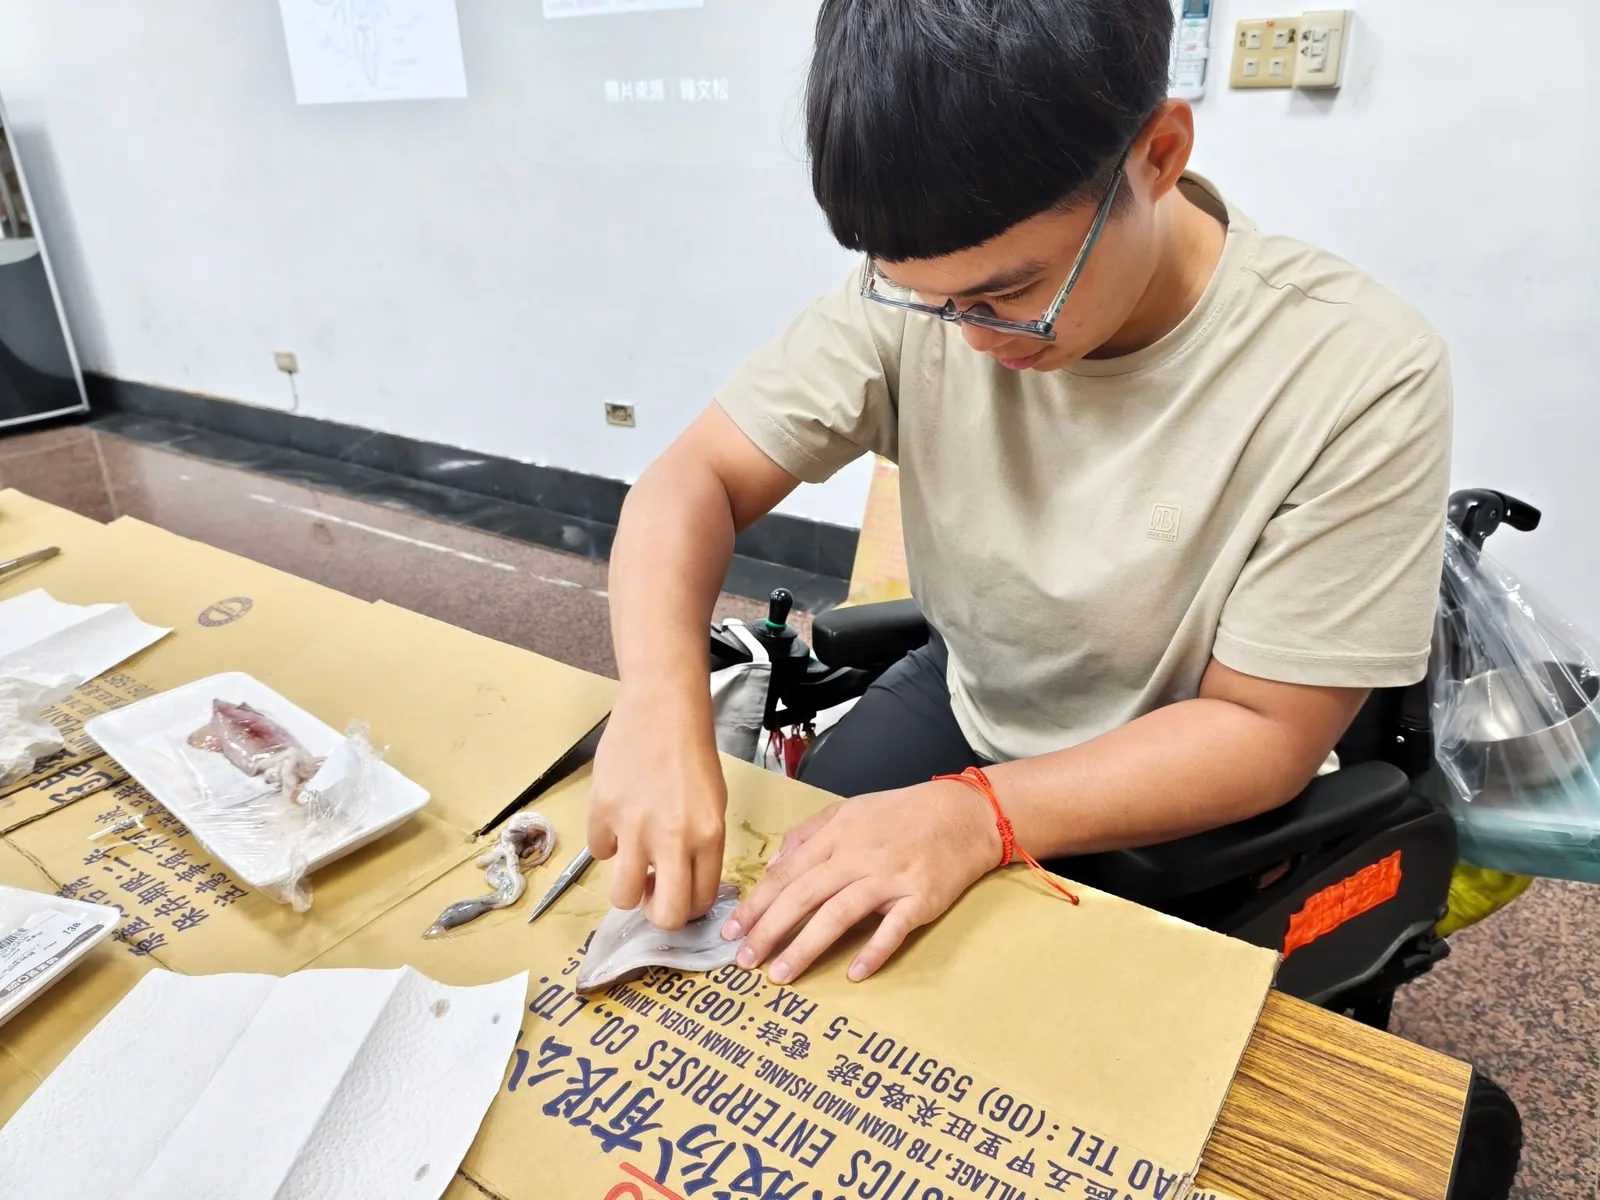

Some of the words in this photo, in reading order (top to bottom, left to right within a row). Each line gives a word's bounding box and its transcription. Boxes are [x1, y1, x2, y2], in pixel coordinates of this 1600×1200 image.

[84, 847, 210, 932] 保存期限:二年
[530, 977, 587, 1026] LTD.
[658, 1006, 703, 1039] HSIEN,
[590, 1001, 639, 1055] CO.,
[701, 1032, 752, 1068] TAINAN
[756, 1060, 815, 1099] HSIANG,
[825, 1017, 973, 1102] 5951101-5
[508, 1029, 845, 1200] 股份有限公
[634, 1040, 836, 1168] ENTERPRISES
[813, 1091, 858, 1125] MIAO
[829, 1056, 1132, 1200] 區五甲里旺萊路6號
[858, 1115, 905, 1150] KUAN
